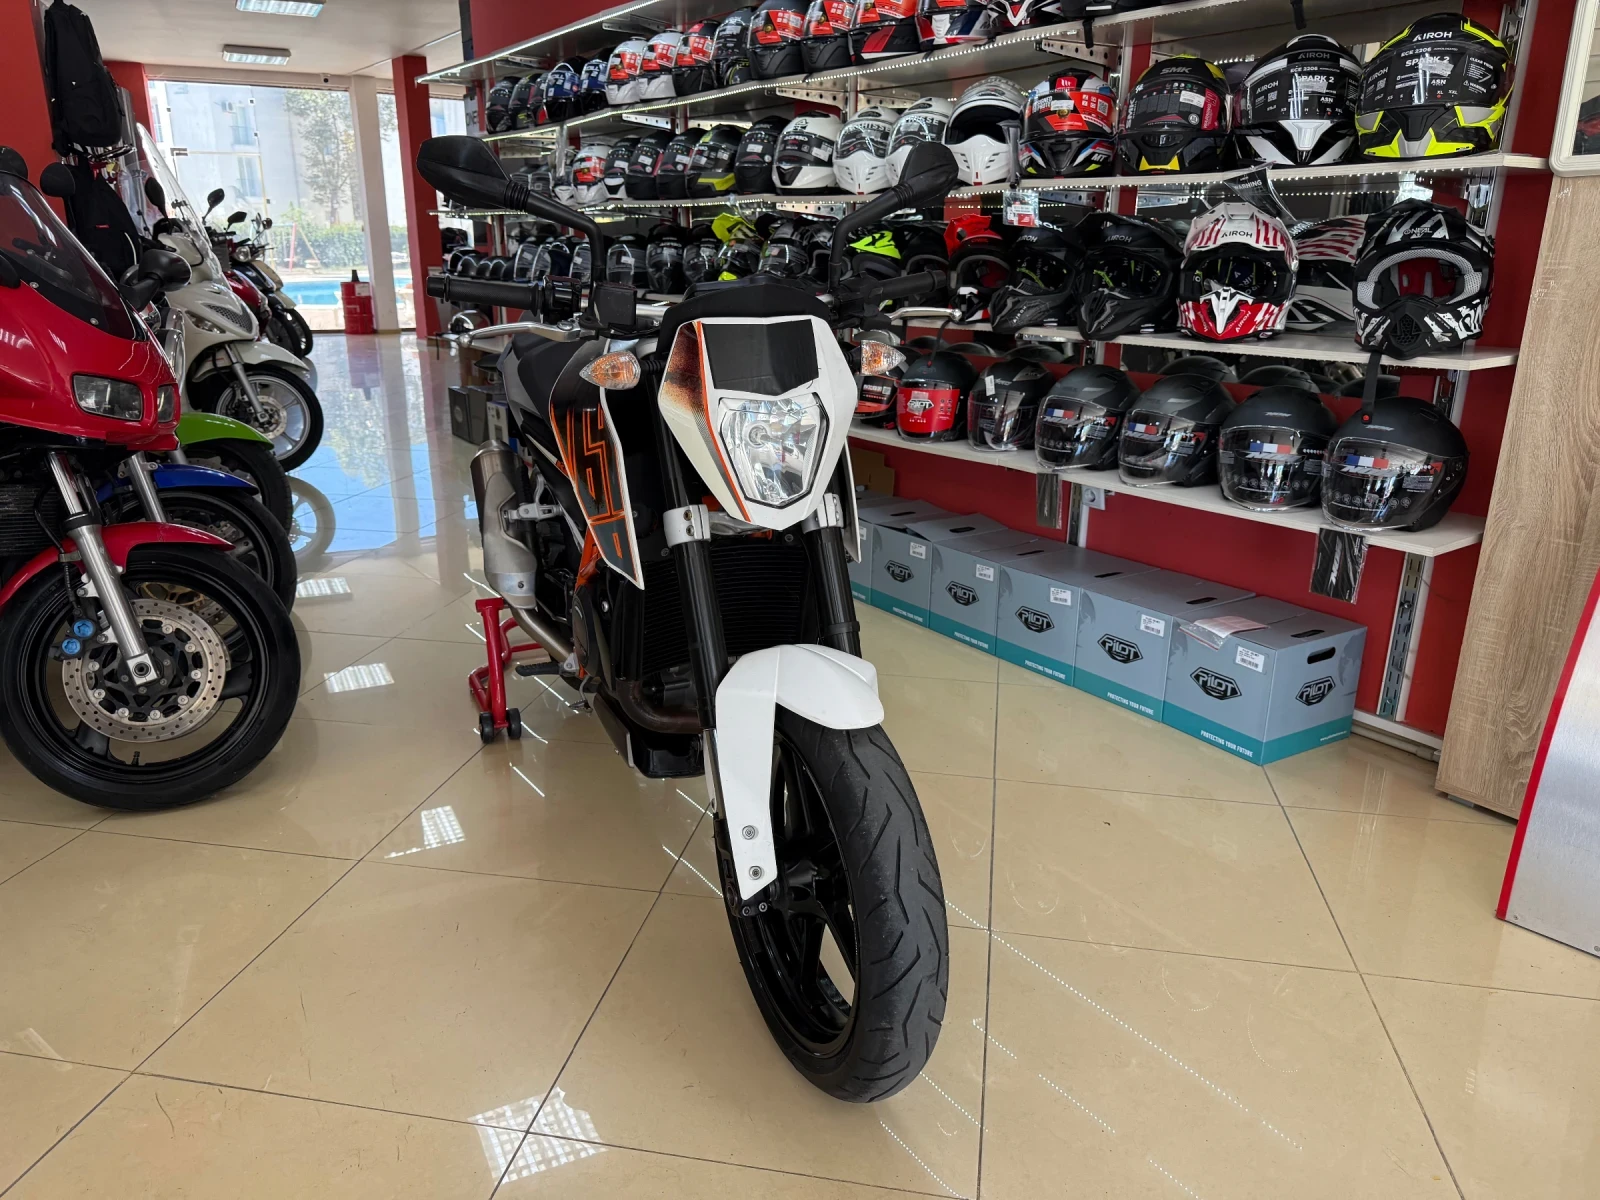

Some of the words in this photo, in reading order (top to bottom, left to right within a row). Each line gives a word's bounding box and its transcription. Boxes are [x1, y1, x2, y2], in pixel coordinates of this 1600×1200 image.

[1412, 31, 1453, 42] AIROH
[1160, 66, 1193, 75] SMK
[1328, 76, 1335, 84] 2
[1367, 67, 1389, 84] AIROH
[1255, 80, 1279, 94] AIROH
[1091, 153, 1108, 162] MT
[1220, 230, 1253, 238] AIROH
[1235, 311, 1252, 333] AIROH
[951, 584, 974, 603] PILOT
[1021, 609, 1050, 630] PILOT
[1104, 638, 1138, 660] PILOT
[1198, 671, 1236, 697] PILOT
[1302, 681, 1331, 701] PILOT
[1107, 691, 1129, 705] PROTECTING
[1129, 700, 1139, 709] YOUR
[1139, 704, 1155, 716] FUTURE
[1200, 729, 1225, 746] PROTECTING
[1225, 740, 1237, 751] YOUR
[1236, 745, 1254, 758] FUTURE
